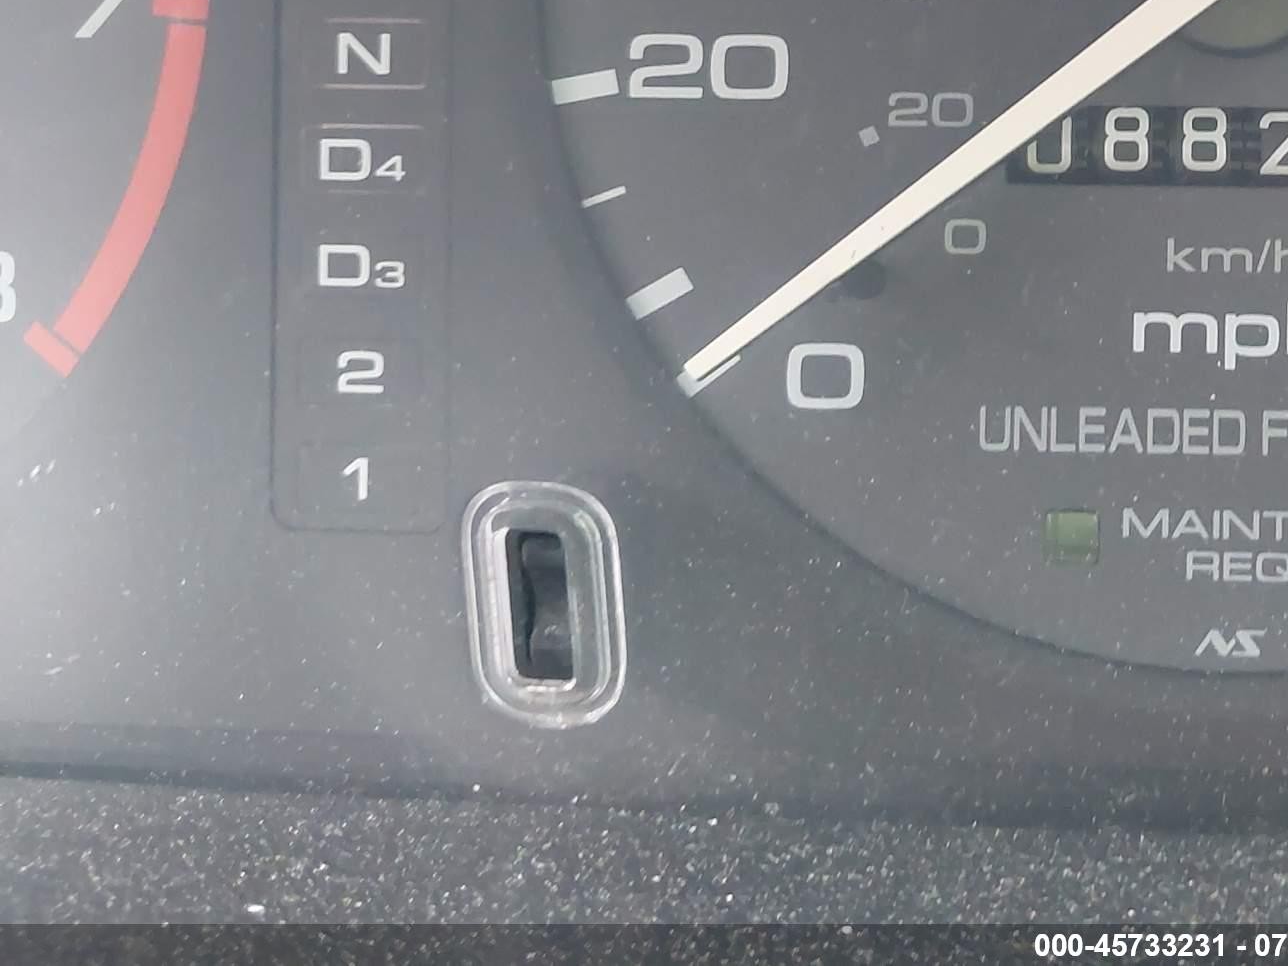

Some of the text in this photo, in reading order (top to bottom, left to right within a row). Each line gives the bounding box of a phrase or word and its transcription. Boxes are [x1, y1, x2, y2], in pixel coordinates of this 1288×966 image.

[338, 33, 390, 74] N
[629, 34, 788, 99] 20
[888, 92, 973, 127] 20
[945, 219, 986, 254] 0
[338, 351, 384, 393] 2
[787, 343, 864, 409] 0
[980, 406, 1245, 455] UNLEADED
[343, 458, 368, 500] 1
